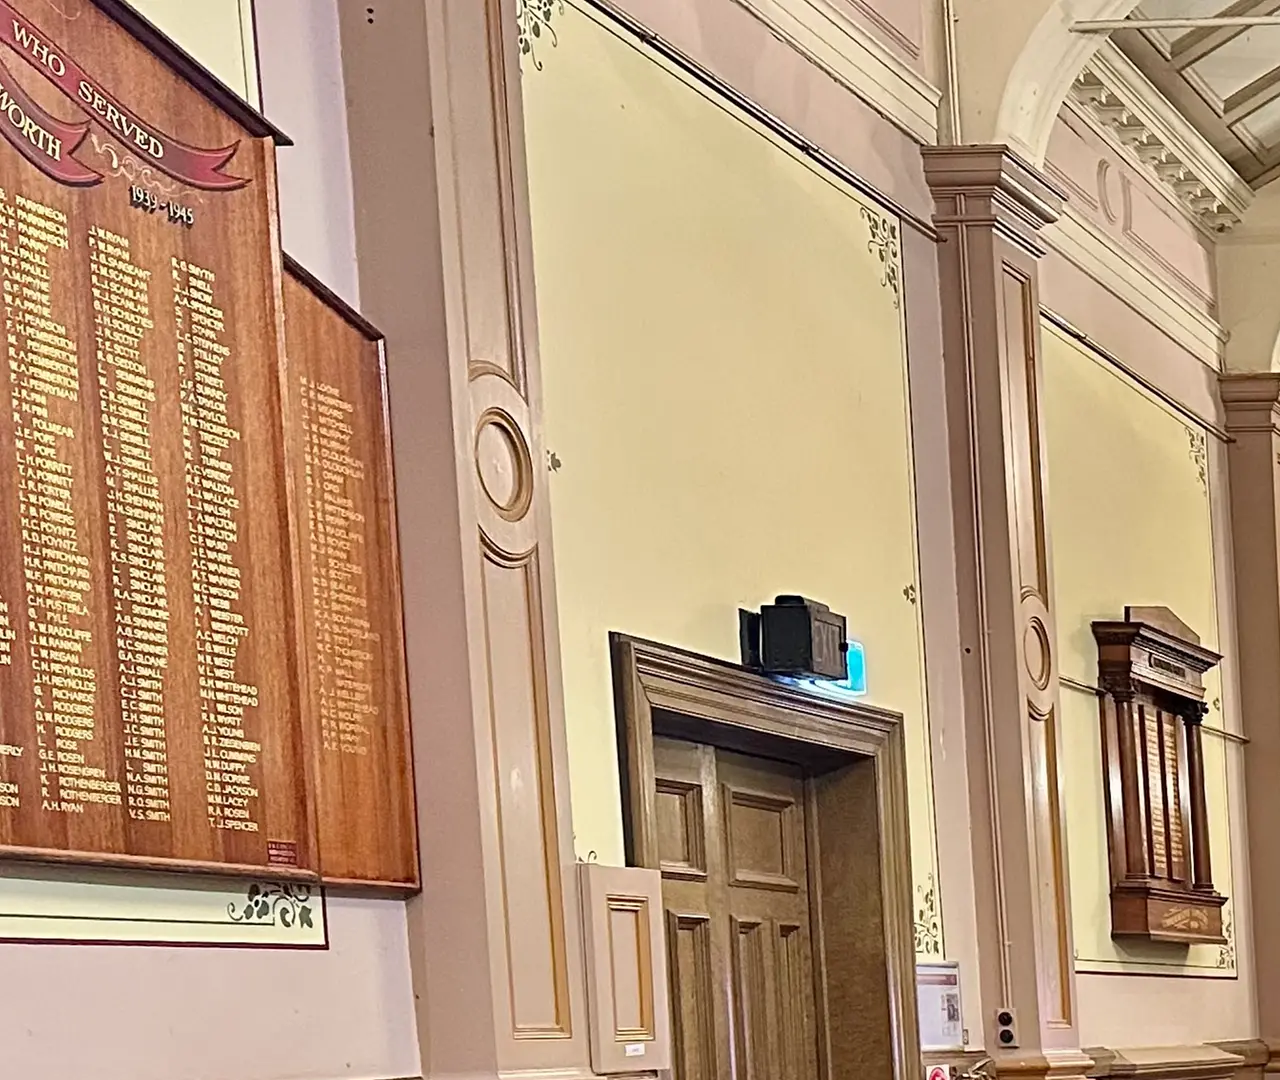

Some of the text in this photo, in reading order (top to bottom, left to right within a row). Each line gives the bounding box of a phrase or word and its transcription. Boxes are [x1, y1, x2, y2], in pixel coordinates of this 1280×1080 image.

[12, 19, 165, 159] WHO SERVED
[131, 185, 158, 211] 1939
[169, 200, 194, 225] 1945
